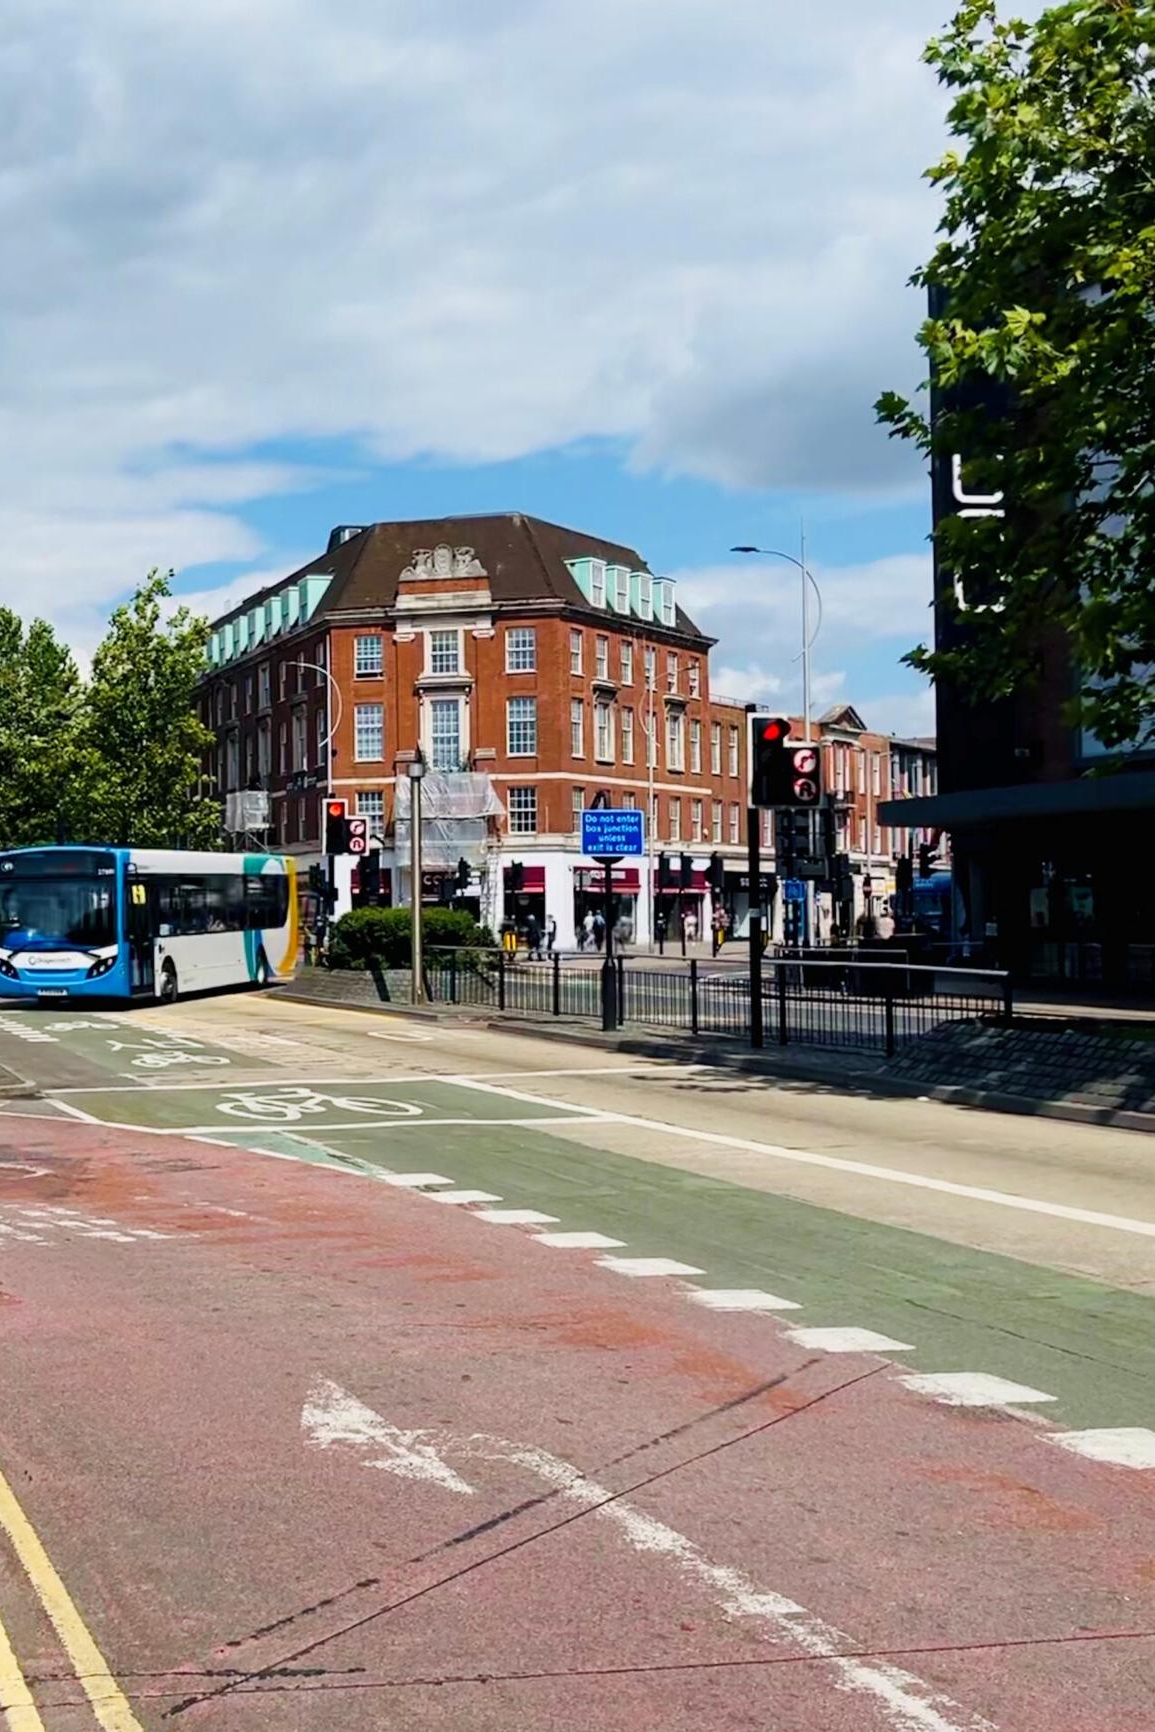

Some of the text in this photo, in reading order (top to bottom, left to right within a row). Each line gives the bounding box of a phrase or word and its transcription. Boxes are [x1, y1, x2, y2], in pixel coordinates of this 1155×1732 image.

[585, 814, 639, 823] Do not enter
[586, 824, 639, 834] box junction
[598, 834, 626, 842] unless
[587, 843, 638, 851] exit is clear
